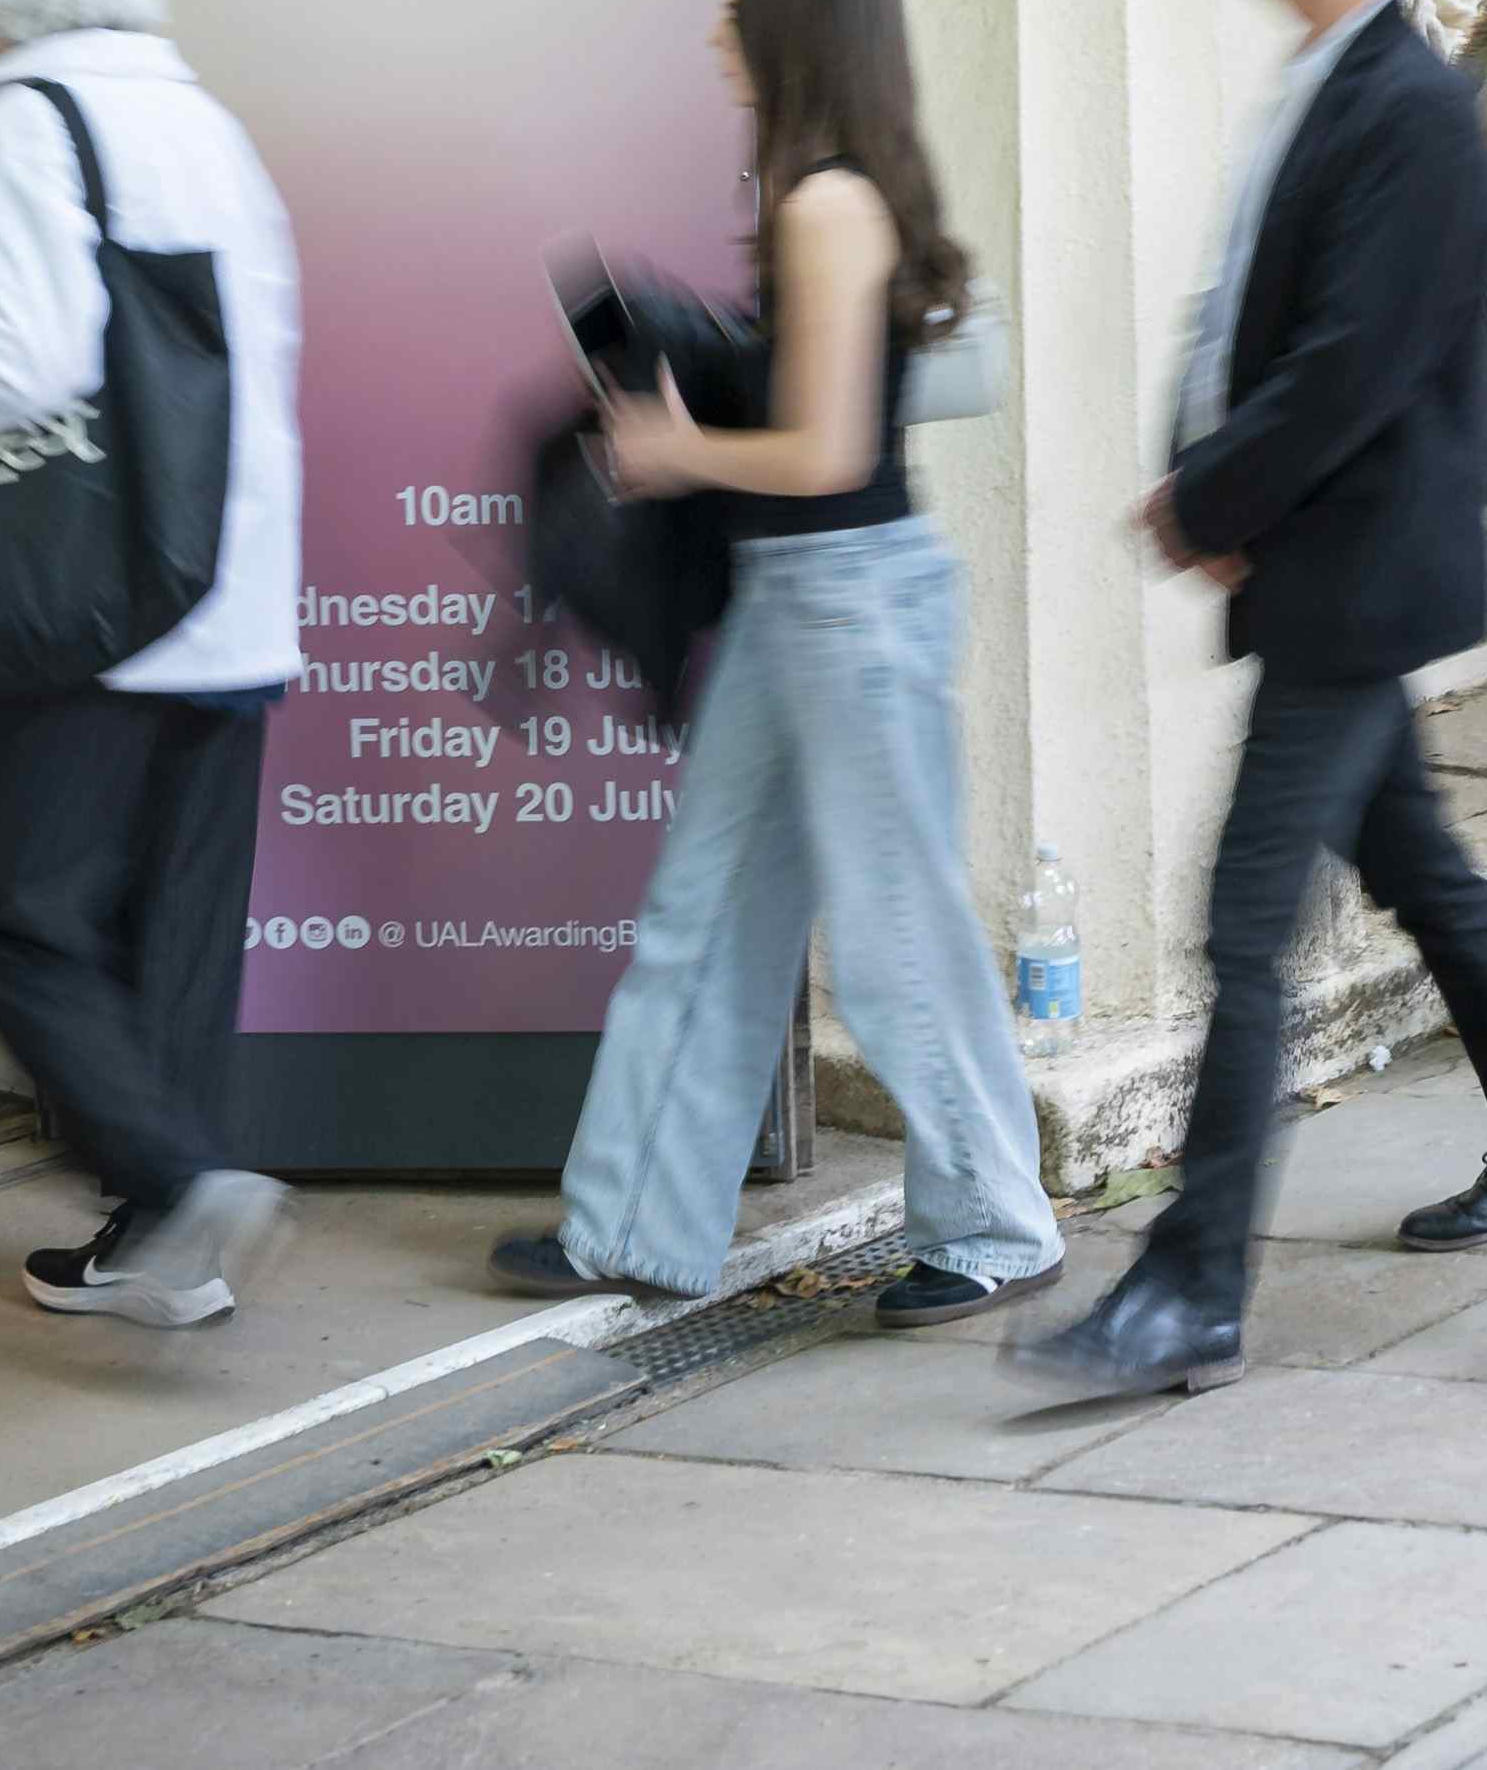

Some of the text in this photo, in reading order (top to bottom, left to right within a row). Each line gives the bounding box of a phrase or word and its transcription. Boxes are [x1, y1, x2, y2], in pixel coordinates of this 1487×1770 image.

[395, 484, 524, 527] 10am
[297, 583, 497, 636] dnesday
[287, 650, 497, 702] hursday
[515, 648, 570, 690] 18
[350, 714, 690, 768] Friday 19 July
[280, 783, 500, 834] Saturday
[515, 781, 574, 822] 20
